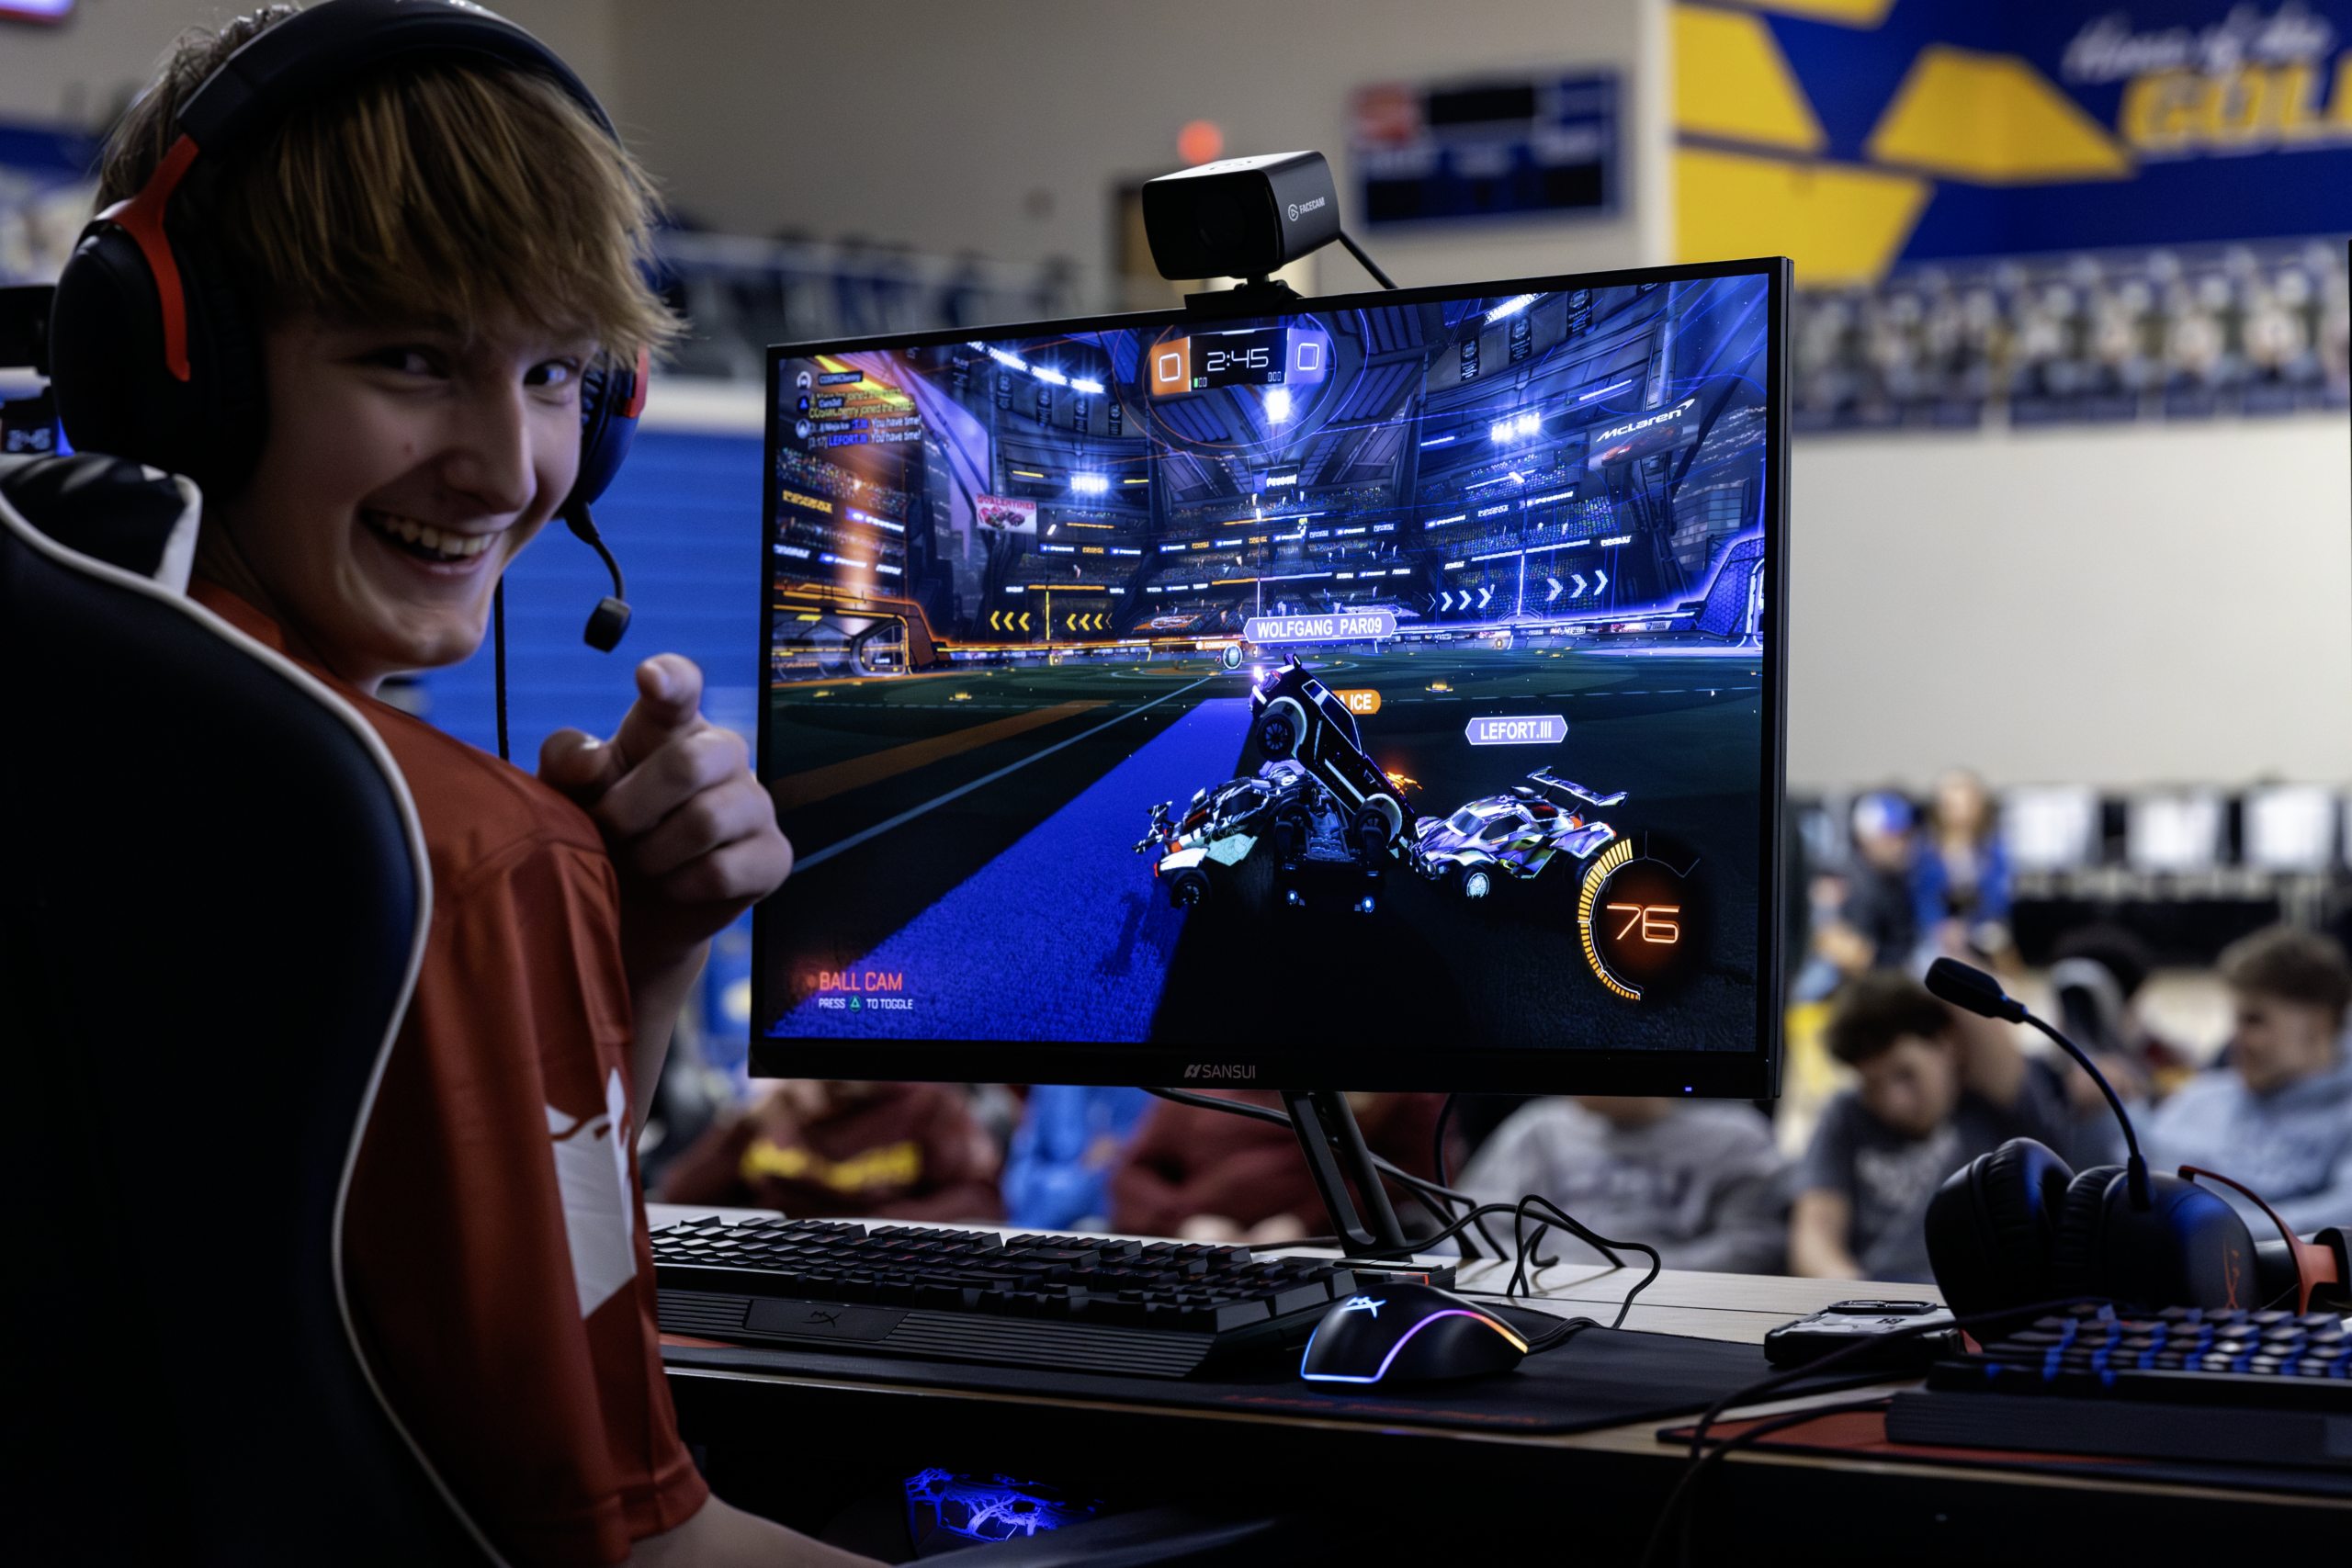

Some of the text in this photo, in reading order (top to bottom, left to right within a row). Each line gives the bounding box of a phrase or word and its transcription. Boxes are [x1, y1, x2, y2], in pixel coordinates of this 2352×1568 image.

[1299, 197, 1326, 214] FACECAM
[1207, 348, 1269, 371] 2:45
[886, 417, 903, 426] have
[1596, 409, 1682, 442] McLaren
[886, 432, 903, 442] have
[1257, 617, 1382, 638] WOLFGANG_PAR09
[1350, 694, 1372, 710] ICE
[1480, 721, 1552, 740] LEFORT.III
[1606, 903, 1680, 944] 76
[820, 972, 903, 991] BALL CAM
[819, 998, 913, 1010] PRESS TO TOGGLE
[1202, 1065, 1256, 1079] SANSUI
